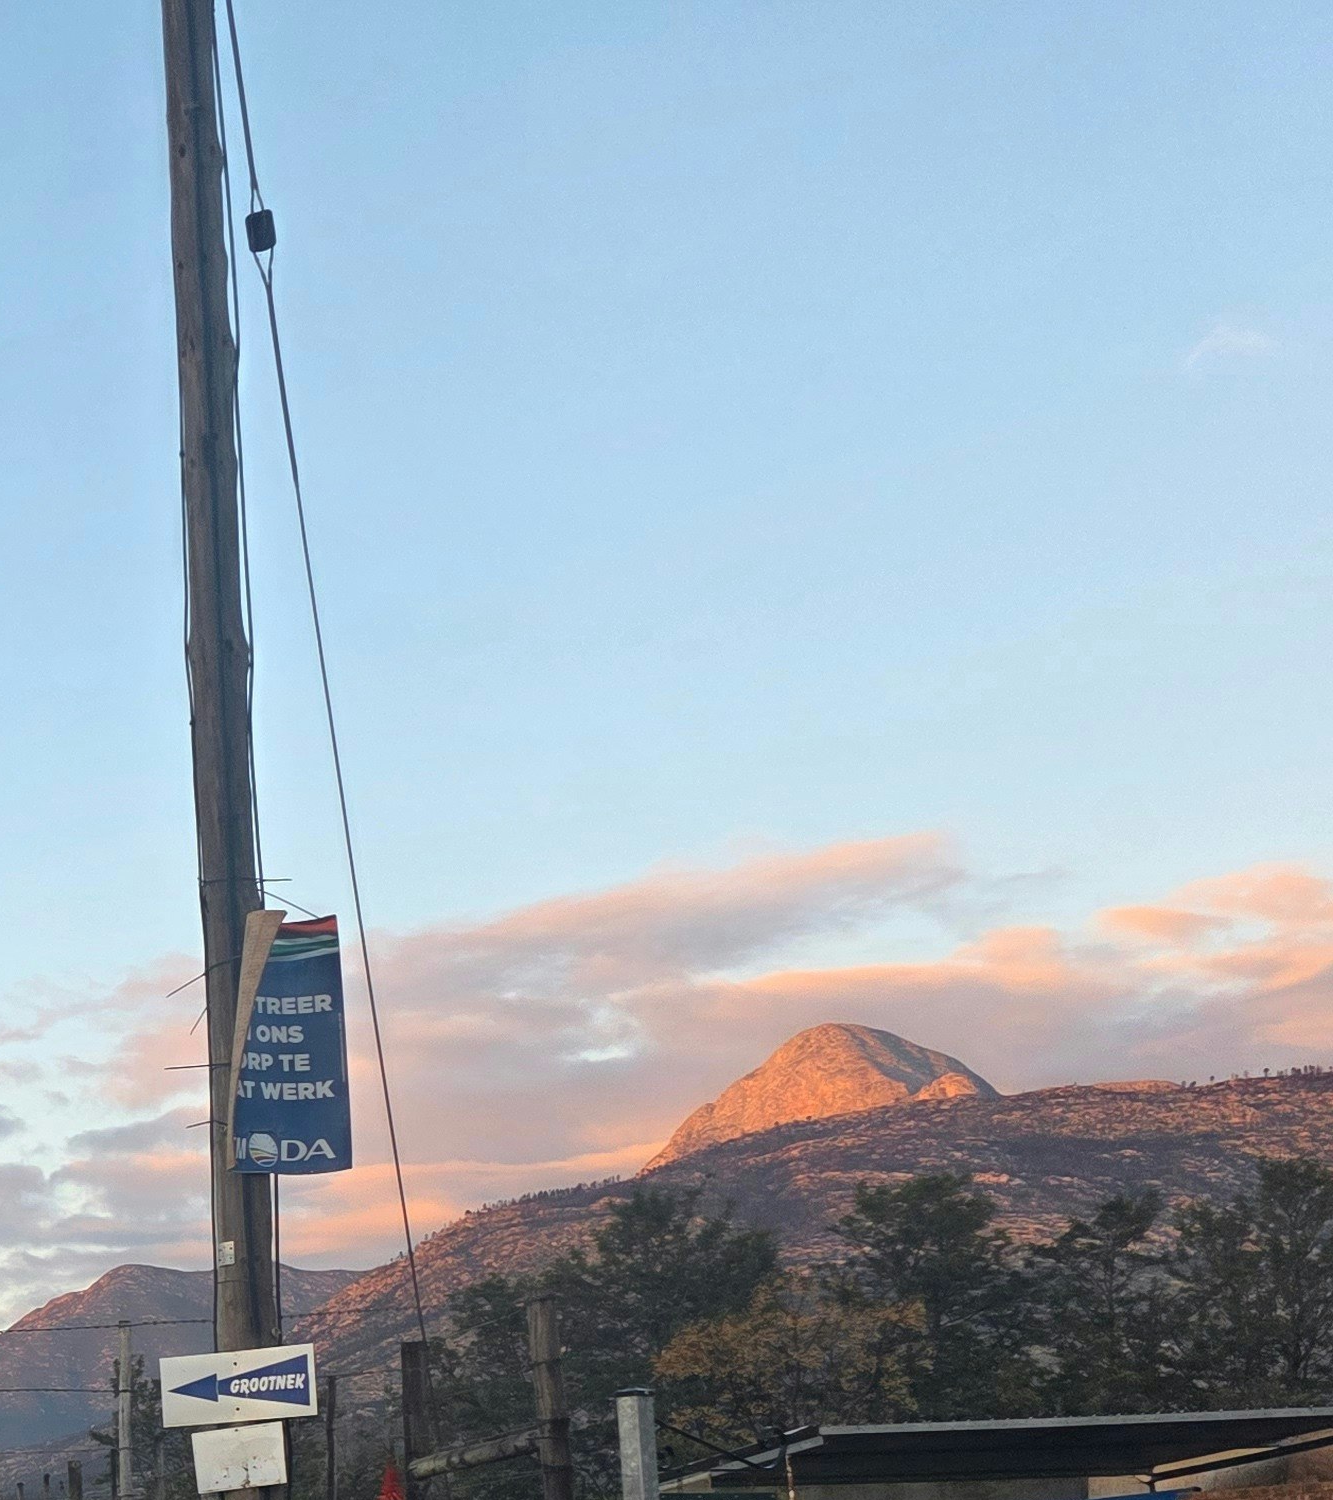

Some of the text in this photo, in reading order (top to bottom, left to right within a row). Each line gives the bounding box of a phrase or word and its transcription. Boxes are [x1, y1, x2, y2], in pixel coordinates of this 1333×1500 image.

[256, 1025, 304, 1043] ONS
[278, 1054, 311, 1072] TE
[261, 1080, 335, 1100] WERK
[281, 1139, 336, 1161] DA
[230, 1374, 305, 1394] GROOTNEK
